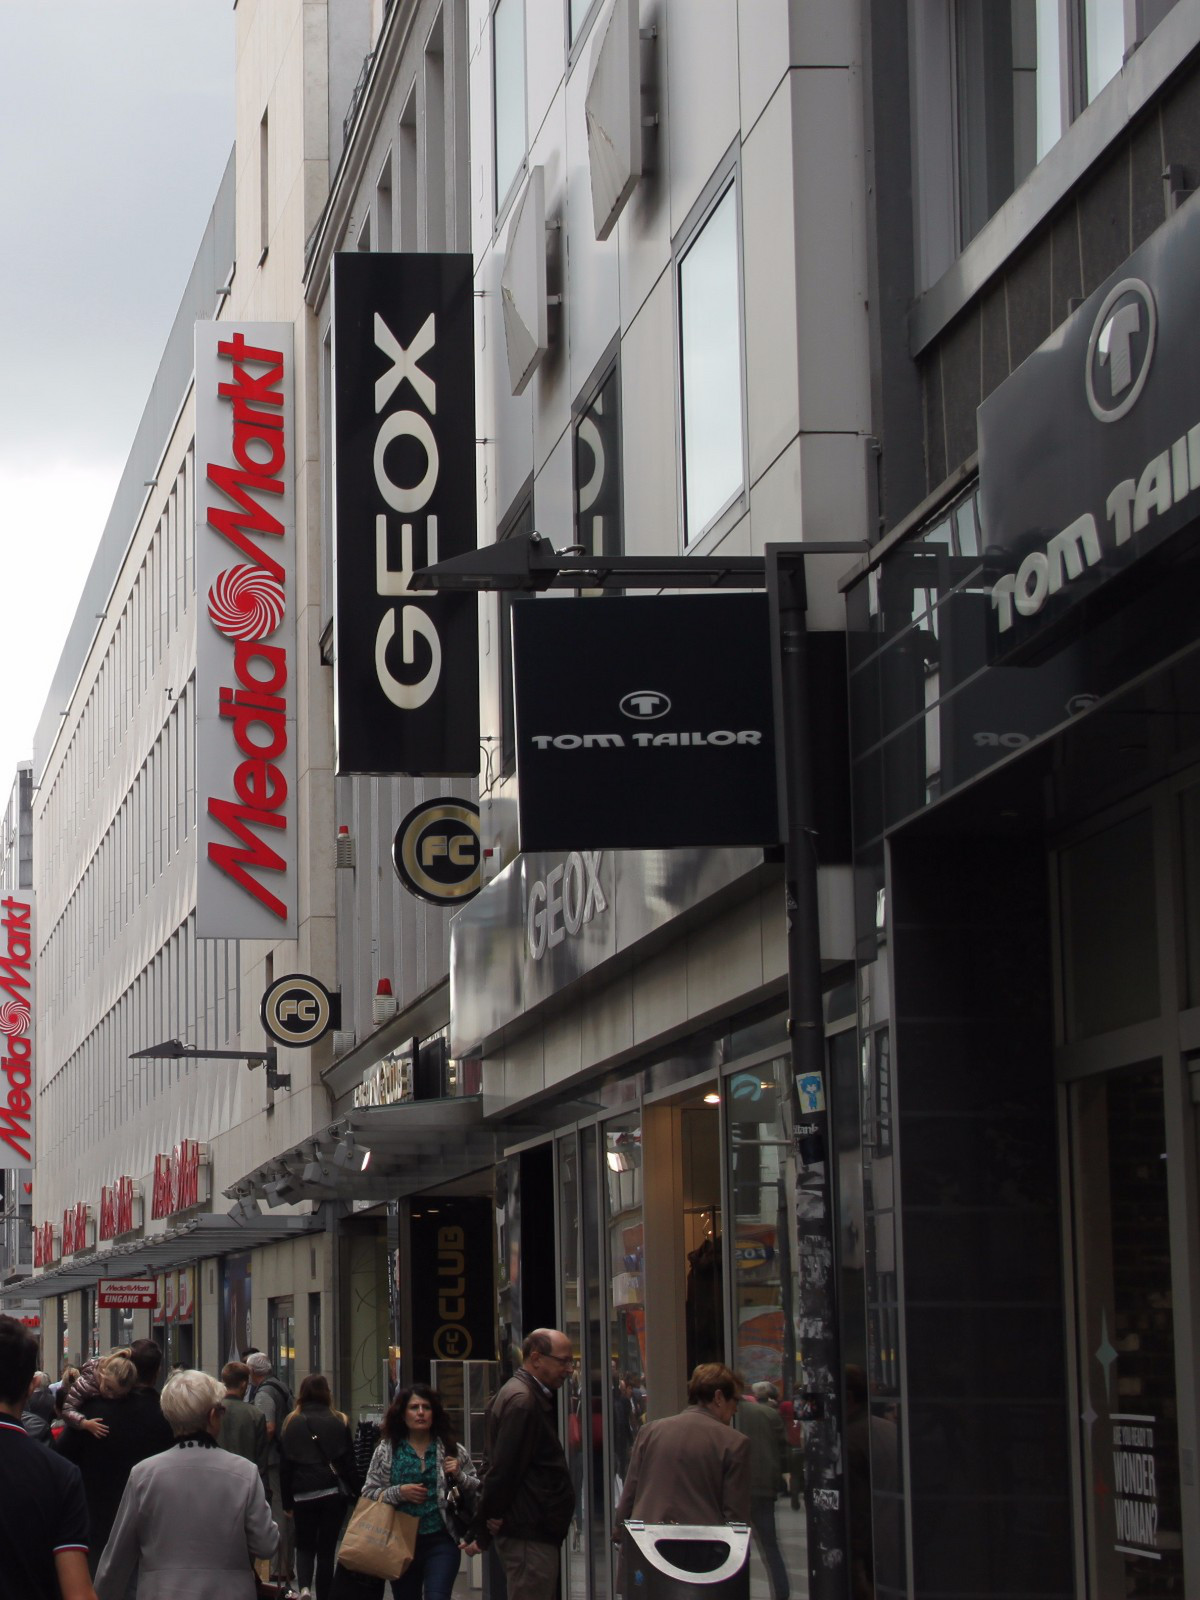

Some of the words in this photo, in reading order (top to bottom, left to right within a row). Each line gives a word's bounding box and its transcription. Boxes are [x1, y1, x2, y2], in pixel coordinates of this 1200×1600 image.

[374, 311, 442, 711] GEOX
[991, 513, 1102, 633] TOM
[531, 733, 625, 750] TOM
[632, 730, 762, 747] TAILOR
[422, 835, 475, 867] FC
[527, 851, 608, 961] GEOX
[279, 1000, 316, 1022] FC
[438, 1225, 465, 1321] CLUB
[104, 1295, 139, 1304] EINGANG
[1113, 1451, 1157, 1497] WONDER
[1114, 1498, 1158, 1546] WOMAN?
